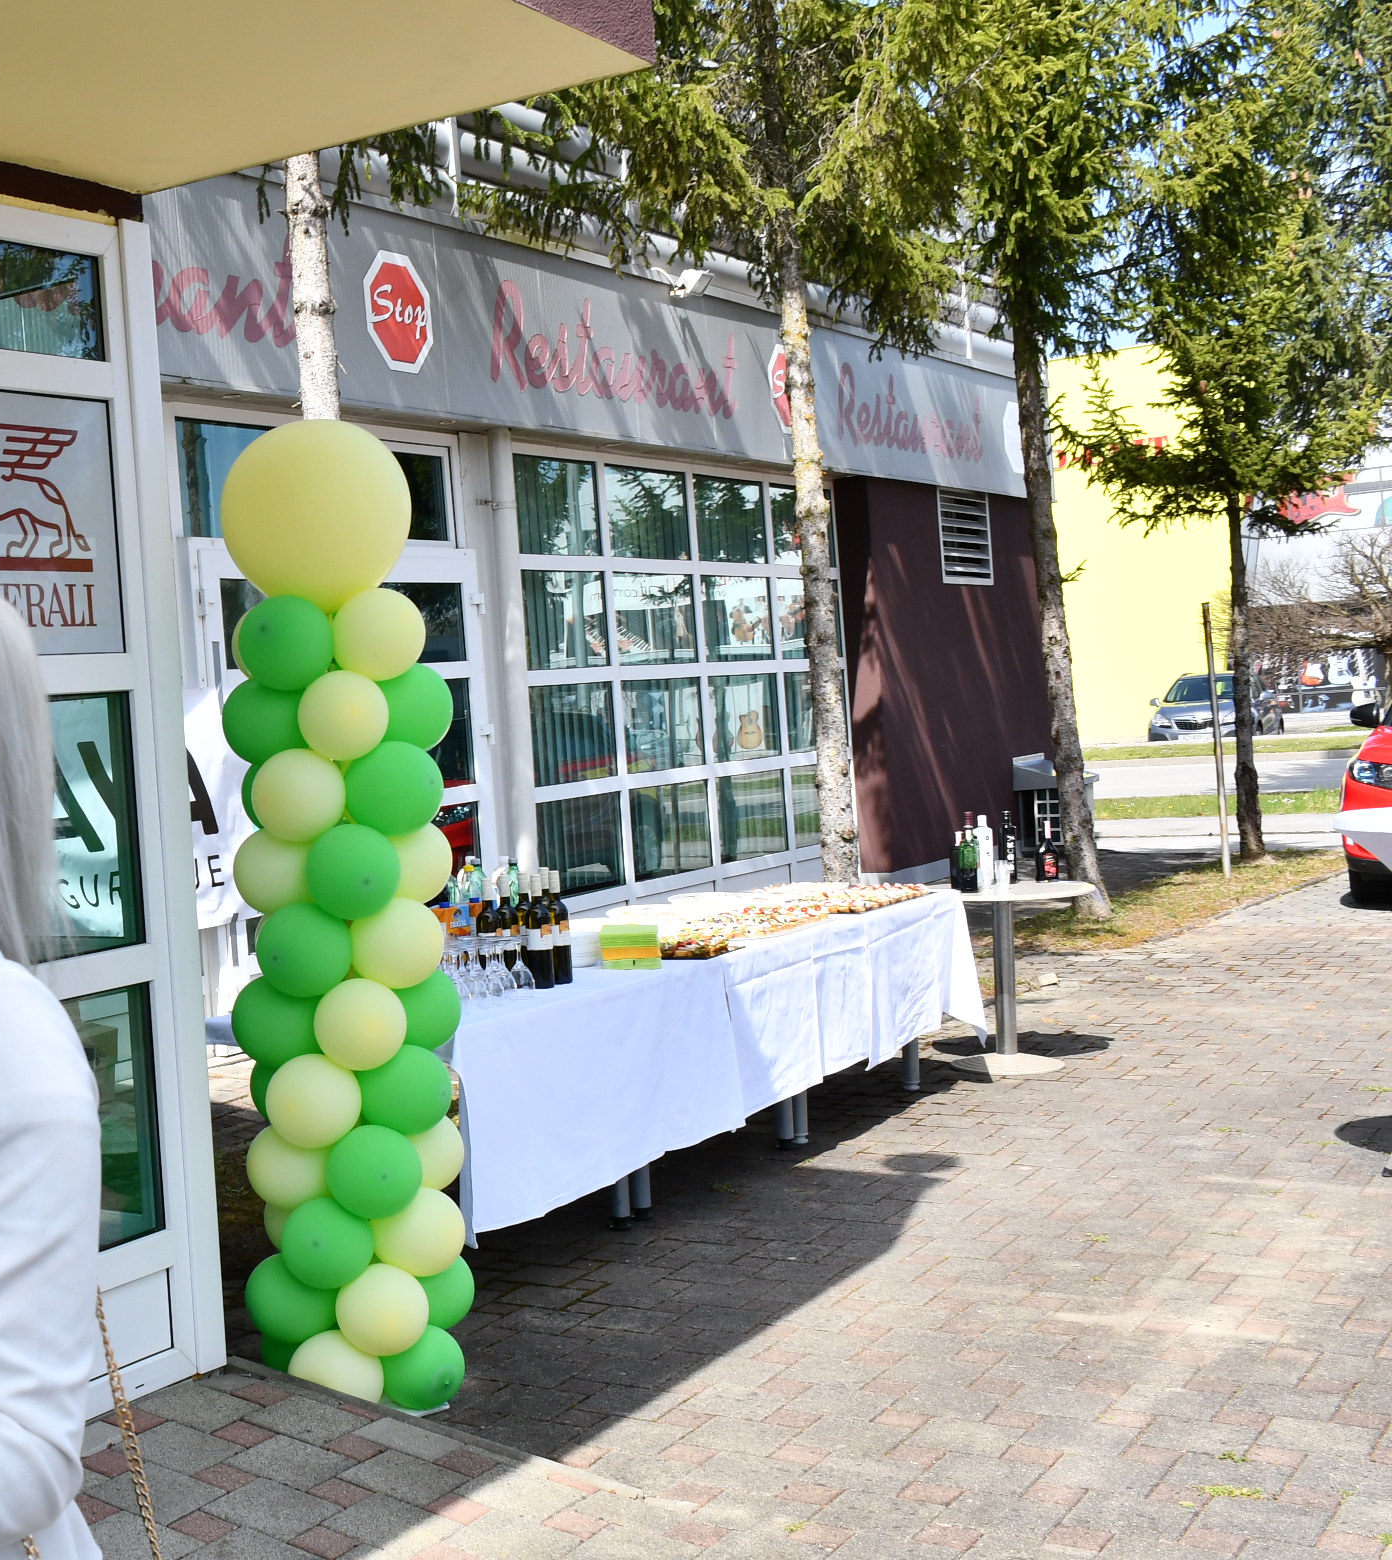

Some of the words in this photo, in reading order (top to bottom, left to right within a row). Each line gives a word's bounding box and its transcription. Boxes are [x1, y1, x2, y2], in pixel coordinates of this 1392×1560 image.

[371, 284, 428, 339] Stop
[491, 279, 738, 419] Restaurant
[837, 362, 983, 463] Restaurant
